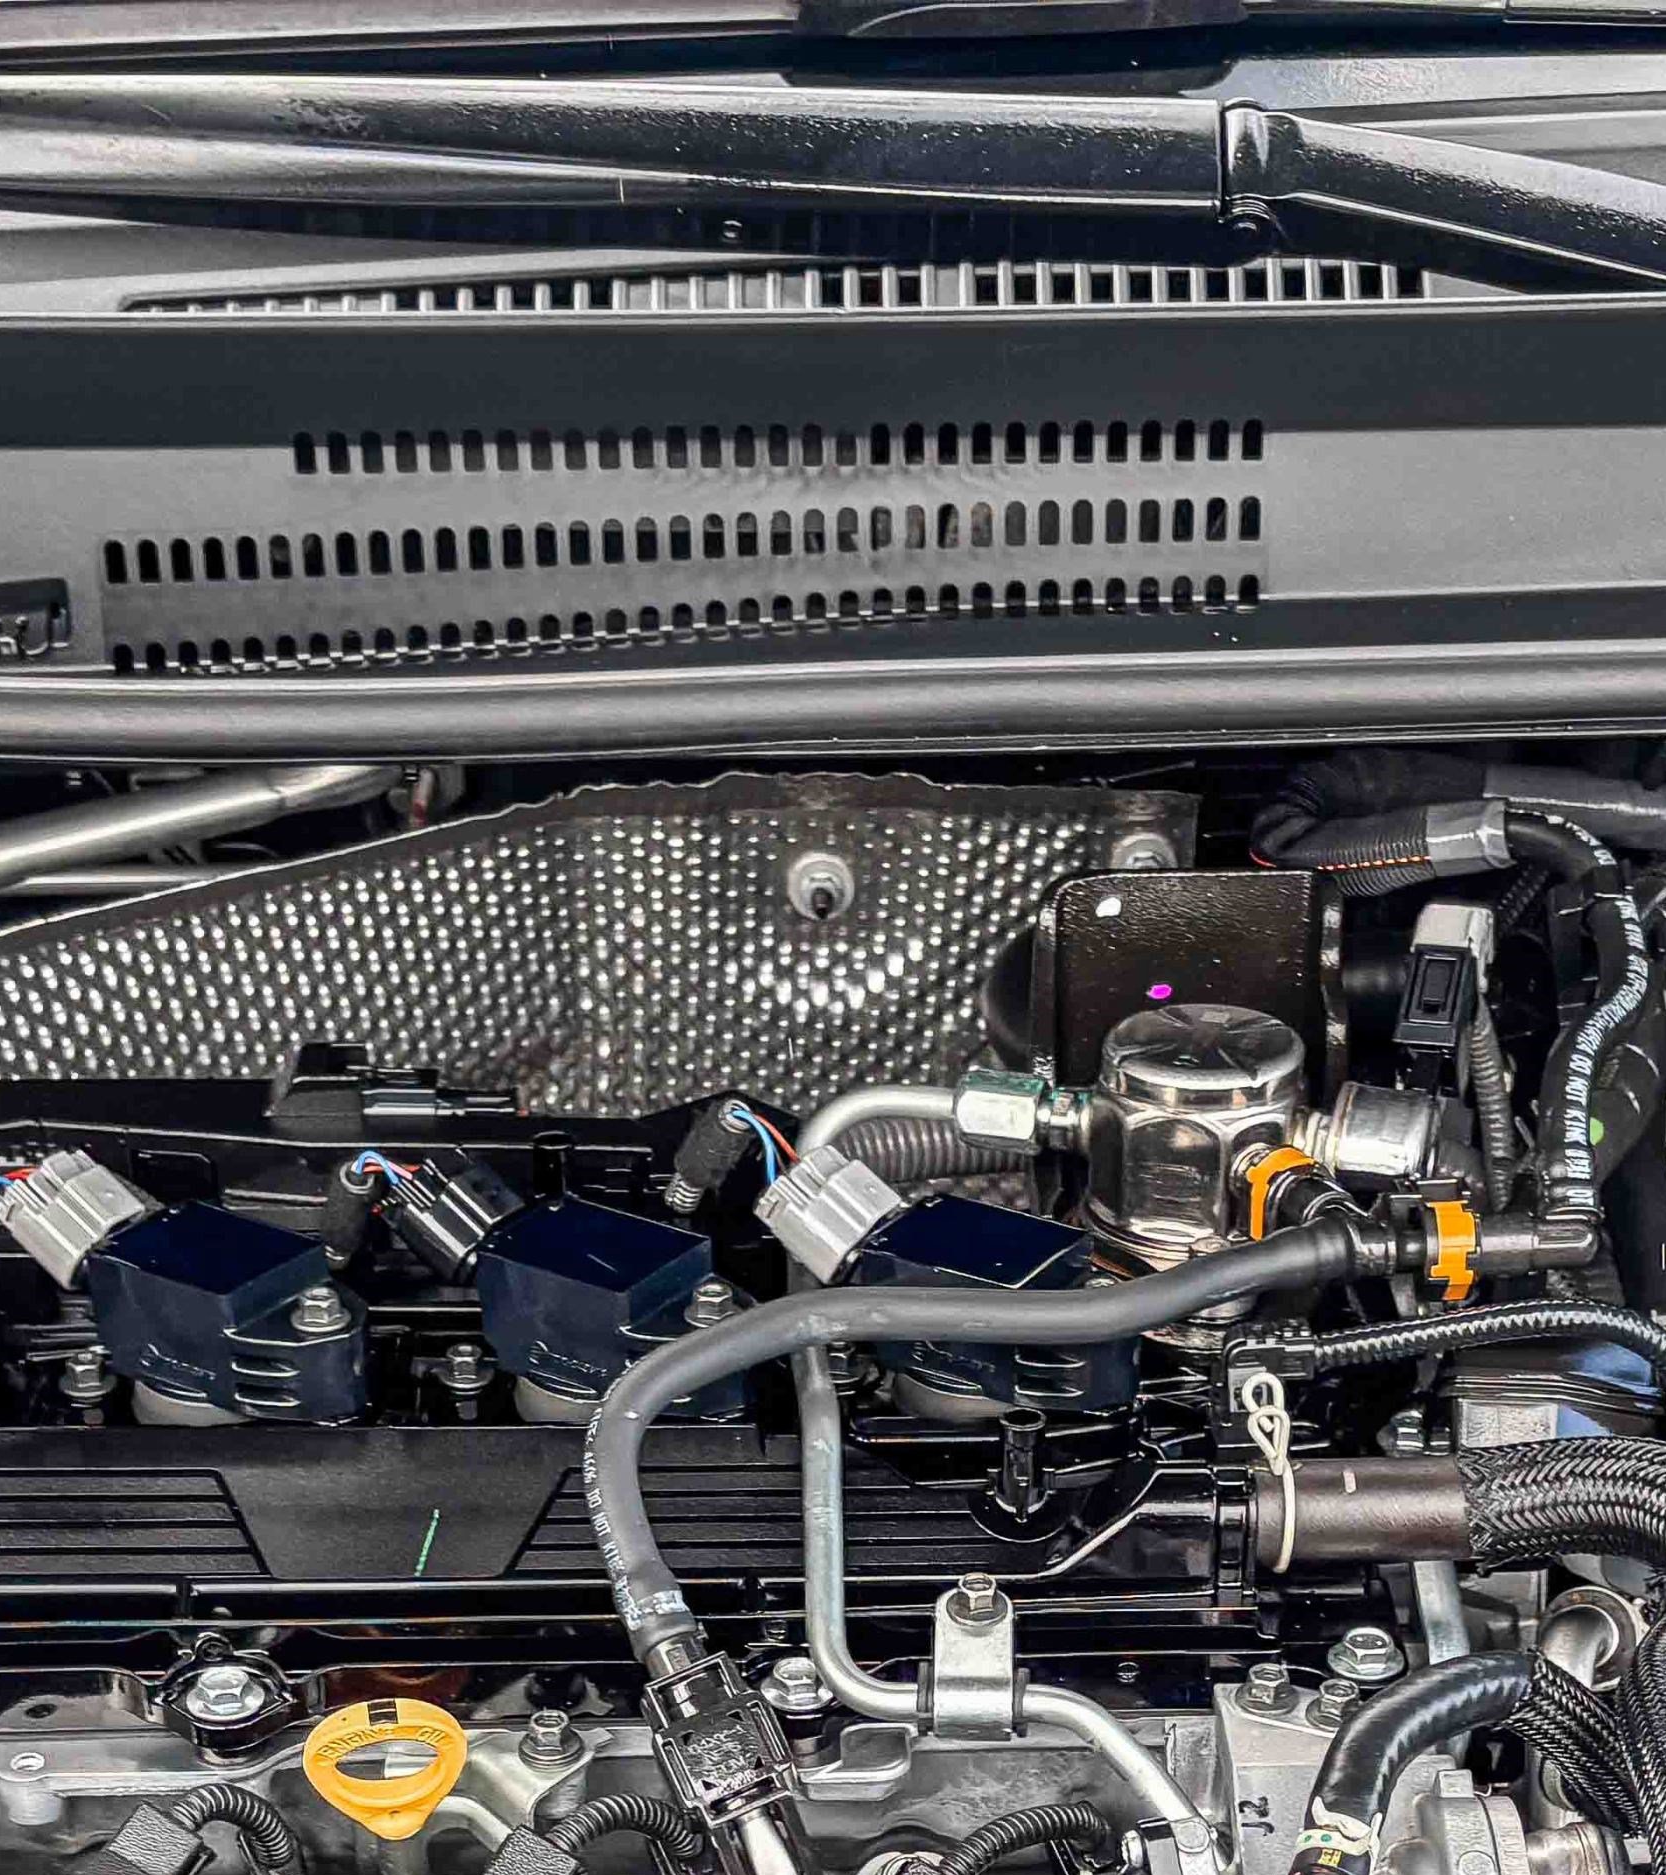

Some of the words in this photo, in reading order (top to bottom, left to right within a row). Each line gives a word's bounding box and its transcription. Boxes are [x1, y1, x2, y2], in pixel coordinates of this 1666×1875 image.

[1565, 1076, 1589, 1106] NOT
[1564, 1109, 1589, 1146] KINK
[586, 1487, 603, 1508] DO
[592, 1512, 611, 1536] NOT
